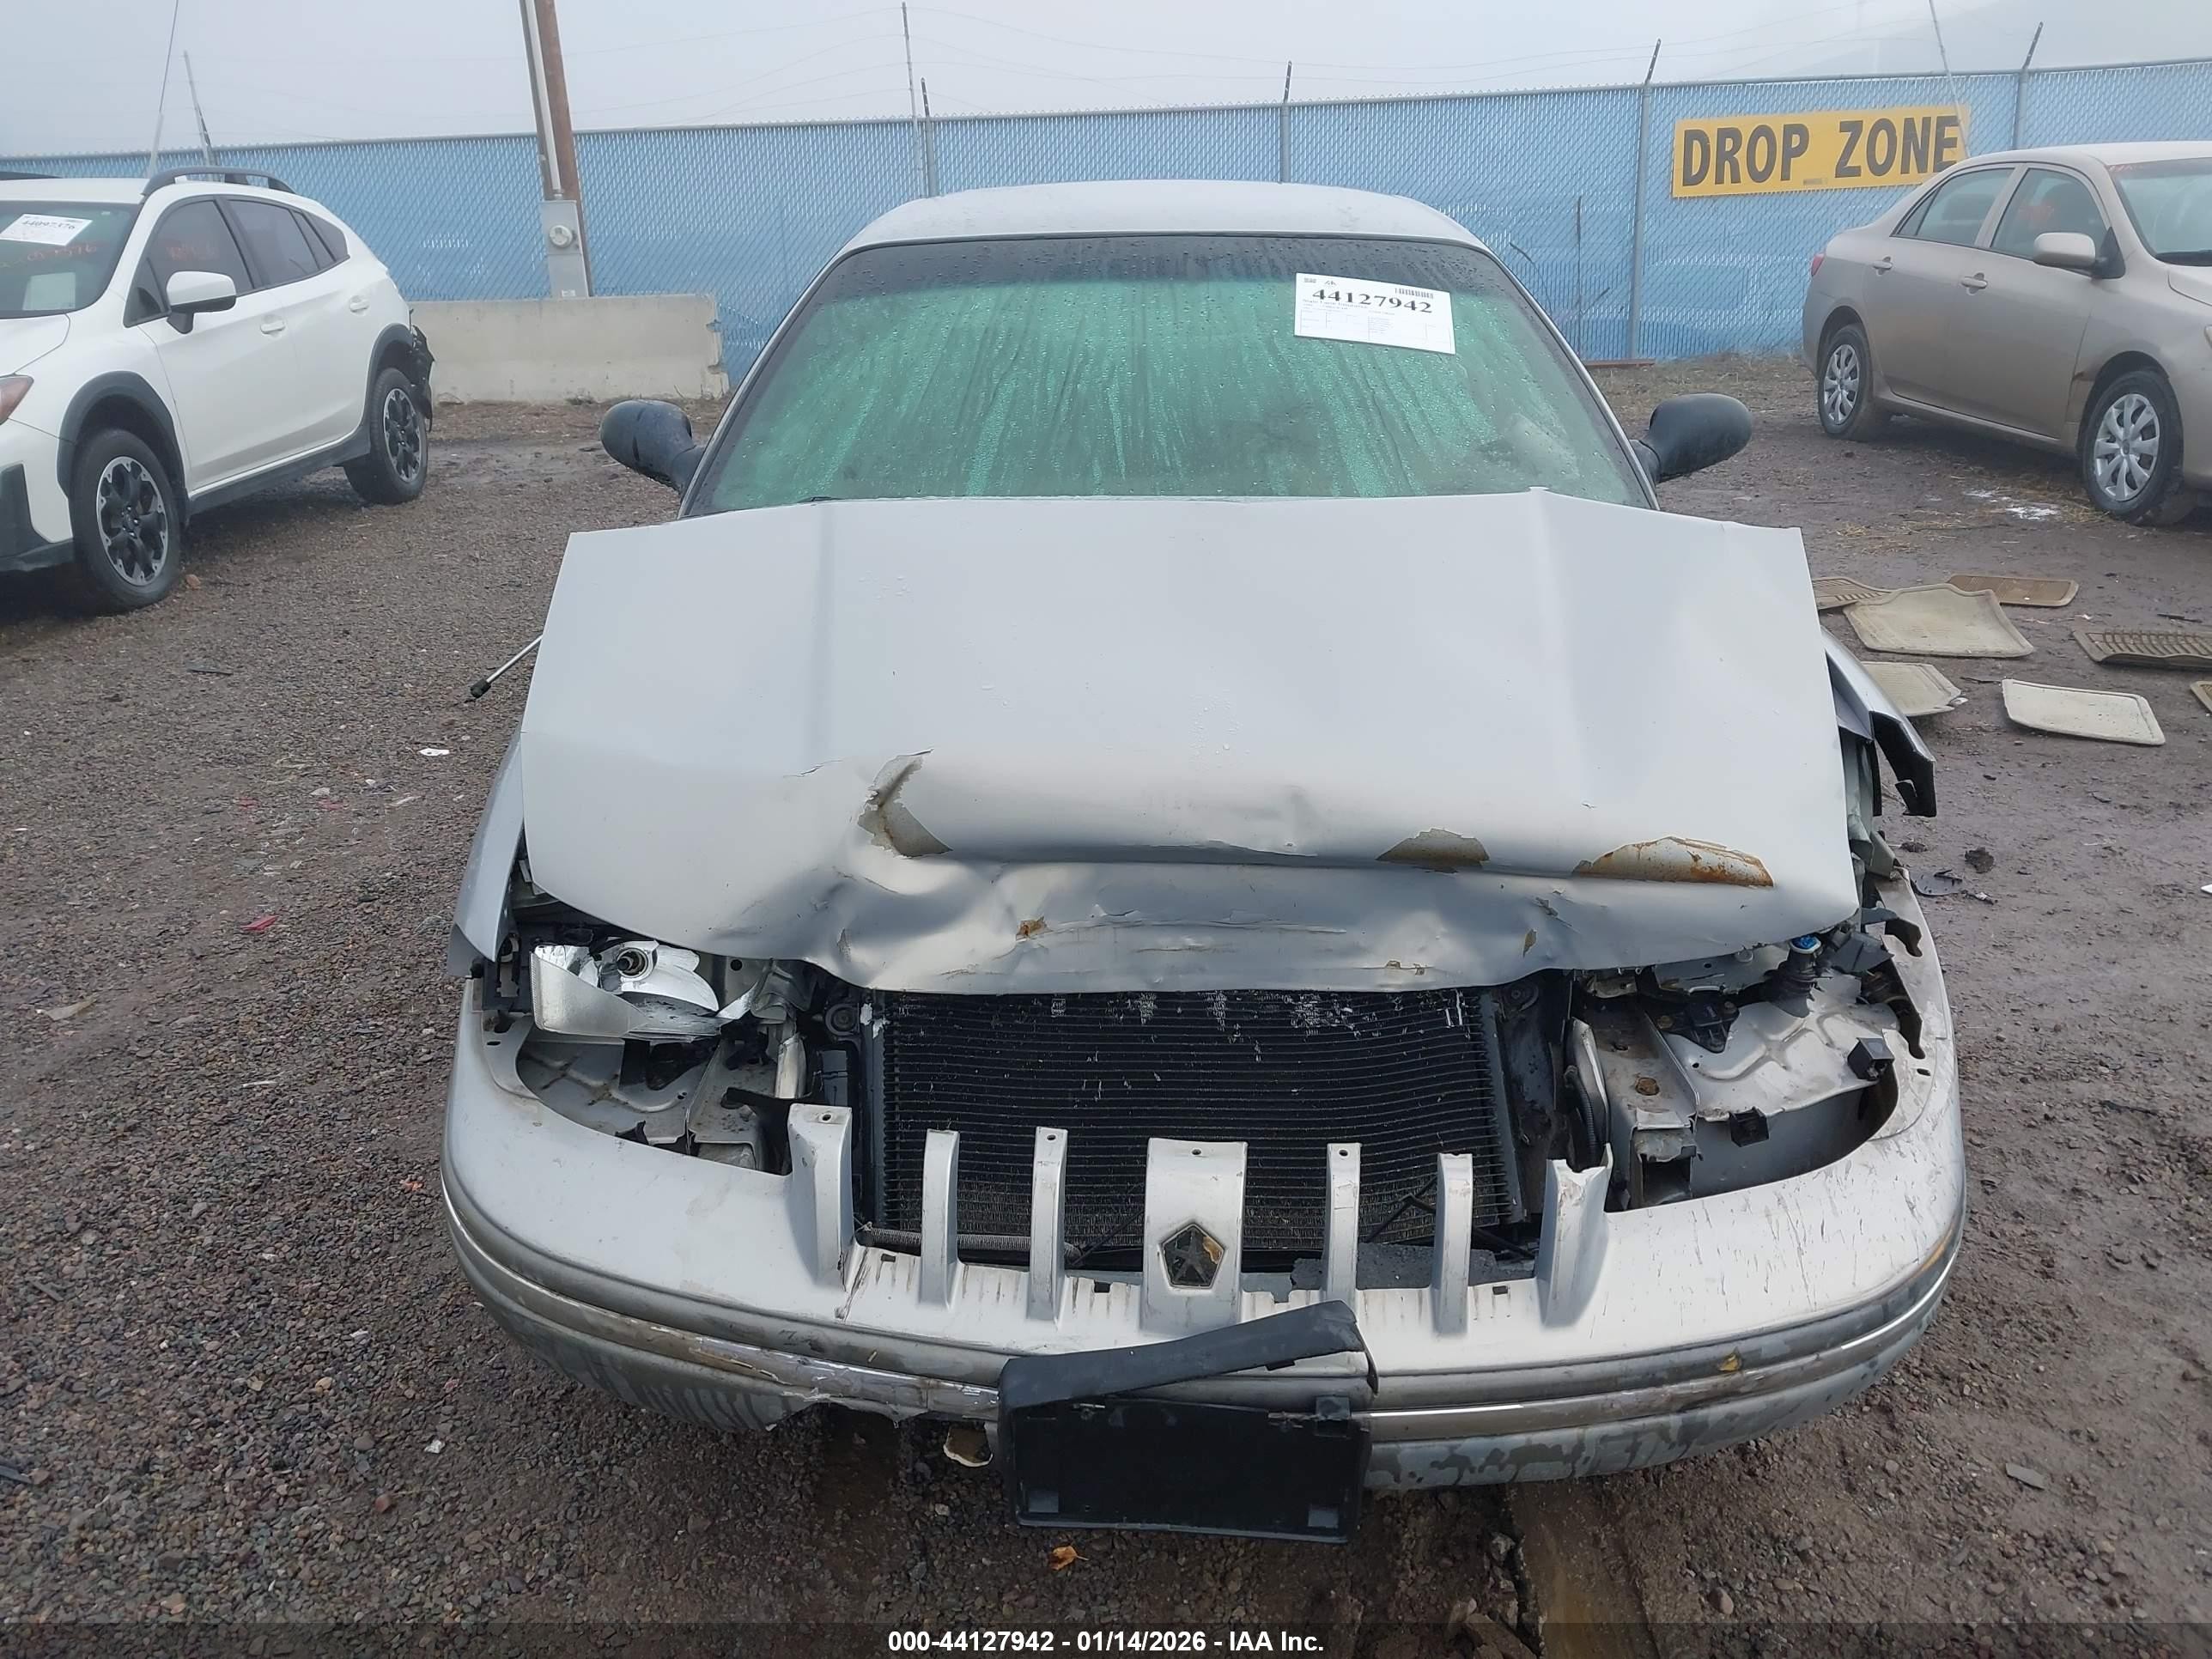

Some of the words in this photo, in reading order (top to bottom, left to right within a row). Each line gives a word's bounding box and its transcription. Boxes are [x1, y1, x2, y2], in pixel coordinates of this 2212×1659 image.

[1682, 123, 1810, 187] DROP
[1834, 115, 1959, 179] ZONE
[1312, 289, 1433, 313] 44127942
